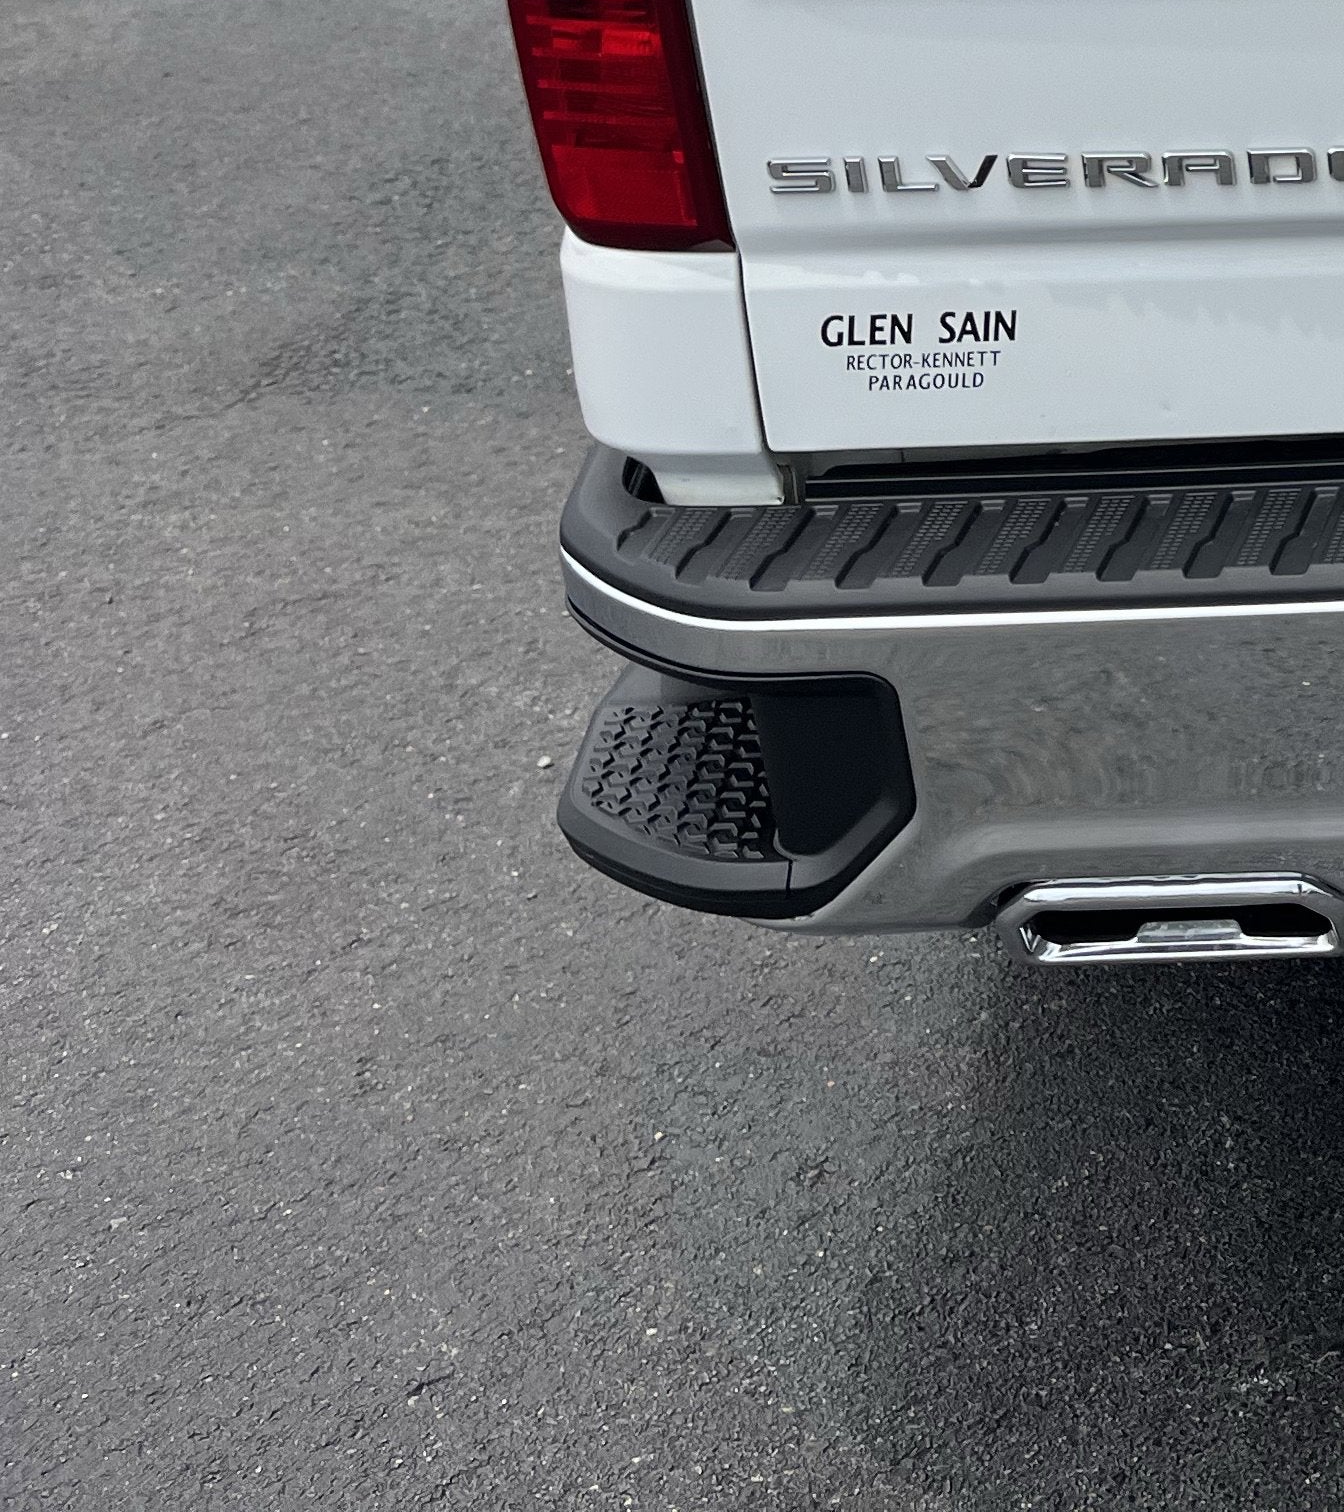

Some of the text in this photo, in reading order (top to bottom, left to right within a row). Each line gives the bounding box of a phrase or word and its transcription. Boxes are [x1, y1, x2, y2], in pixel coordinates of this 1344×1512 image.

[820, 309, 1018, 347] GLEN SAIN
[846, 350, 1002, 371] RECTOR-KENNETT
[867, 371, 985, 392] PARAGOULD
